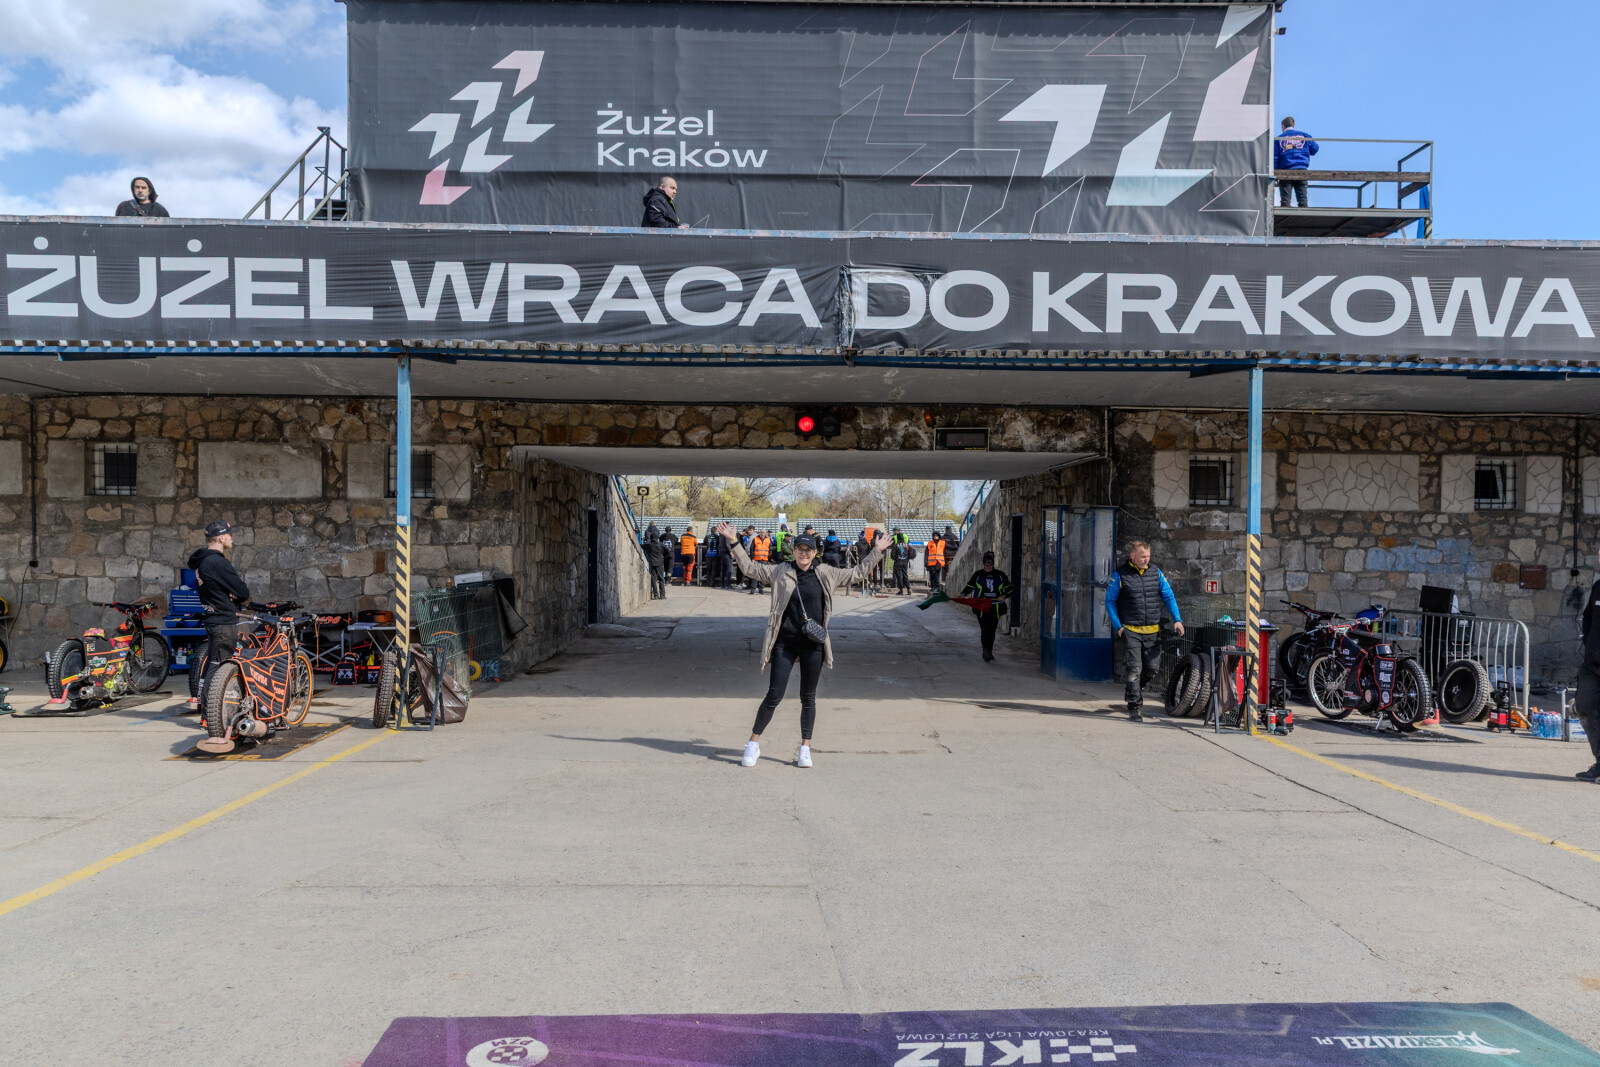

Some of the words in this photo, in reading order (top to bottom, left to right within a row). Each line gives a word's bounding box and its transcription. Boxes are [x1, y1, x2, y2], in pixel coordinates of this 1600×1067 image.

[596, 102, 714, 136] Żużel
[6, 236, 374, 320] ŻUŻEL
[390, 259, 823, 328] WRACA
[850, 269, 1010, 332] DO
[1032, 271, 1596, 338] KRAKOWA
[985, 1031, 1021, 1039] LIGA
[1028, 1029, 1109, 1038] KRAJOWA
[491, 1038, 534, 1047] PZM
